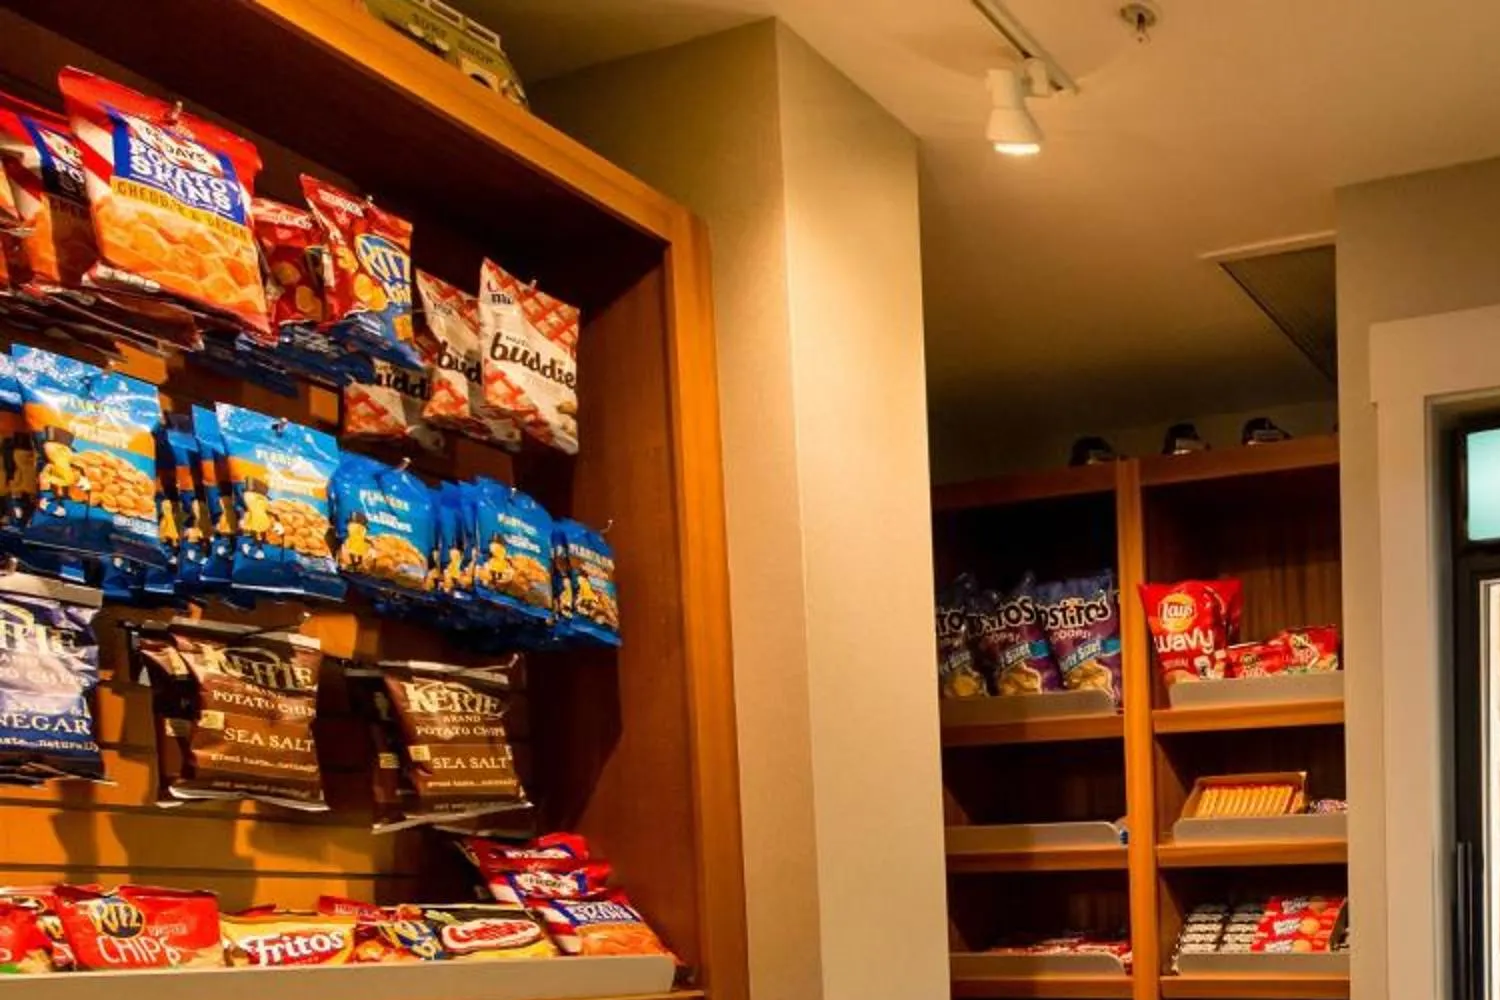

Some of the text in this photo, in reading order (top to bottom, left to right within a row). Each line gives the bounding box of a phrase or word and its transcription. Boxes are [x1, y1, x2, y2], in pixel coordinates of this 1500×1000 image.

[130, 155, 231, 212] SKINS
[490, 331, 577, 390] buddie
[212, 688, 275, 709] POTATO
[0, 710, 92, 735] NEGAR
[415, 725, 471, 739] POTATO
[223, 726, 315, 753] SEA SALT
[431, 755, 509, 770] SEA SALT
[249, 928, 346, 967] Fritos
